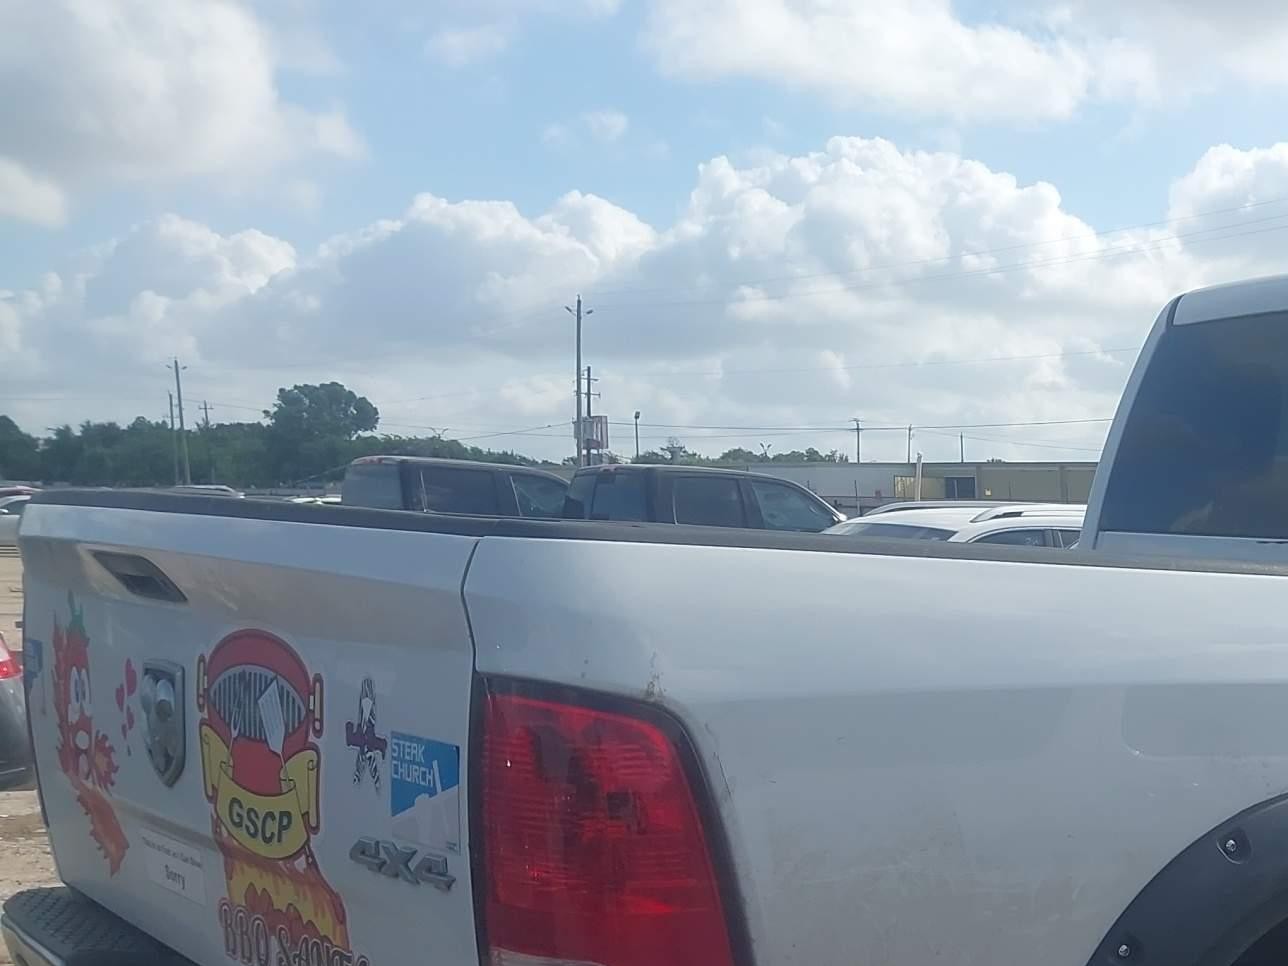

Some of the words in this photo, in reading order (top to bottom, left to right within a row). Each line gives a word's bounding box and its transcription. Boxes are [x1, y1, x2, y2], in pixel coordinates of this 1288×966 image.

[391, 738, 425, 763] STEAK
[391, 760, 434, 788] CHURCH
[228, 797, 293, 844] GSCP
